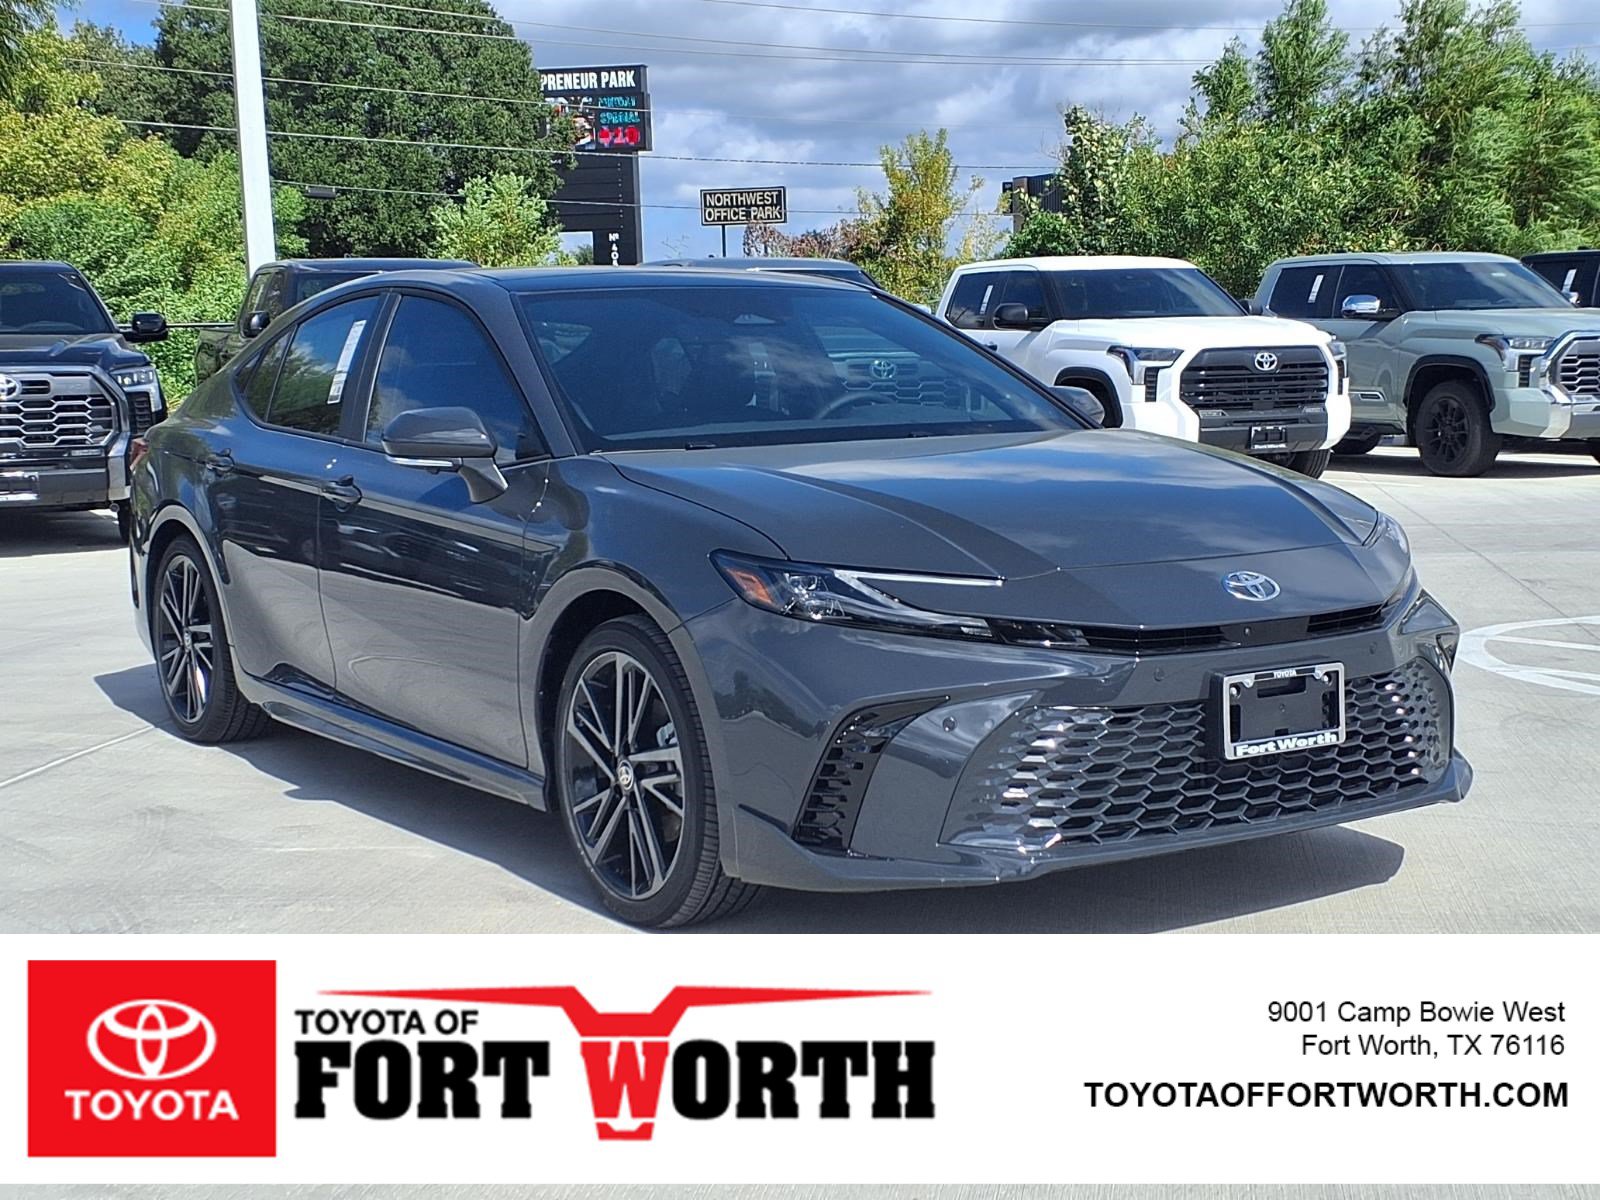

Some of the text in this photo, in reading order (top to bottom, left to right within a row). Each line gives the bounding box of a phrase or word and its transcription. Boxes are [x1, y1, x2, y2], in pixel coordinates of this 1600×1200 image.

[601, 70, 636, 88] PARK
[706, 191, 778, 206] NORTHWEST
[705, 206, 781, 221] OFFICE PARK
[1273, 669, 1297, 679] TOYOTA
[1235, 732, 1338, 758] Fort Worth
